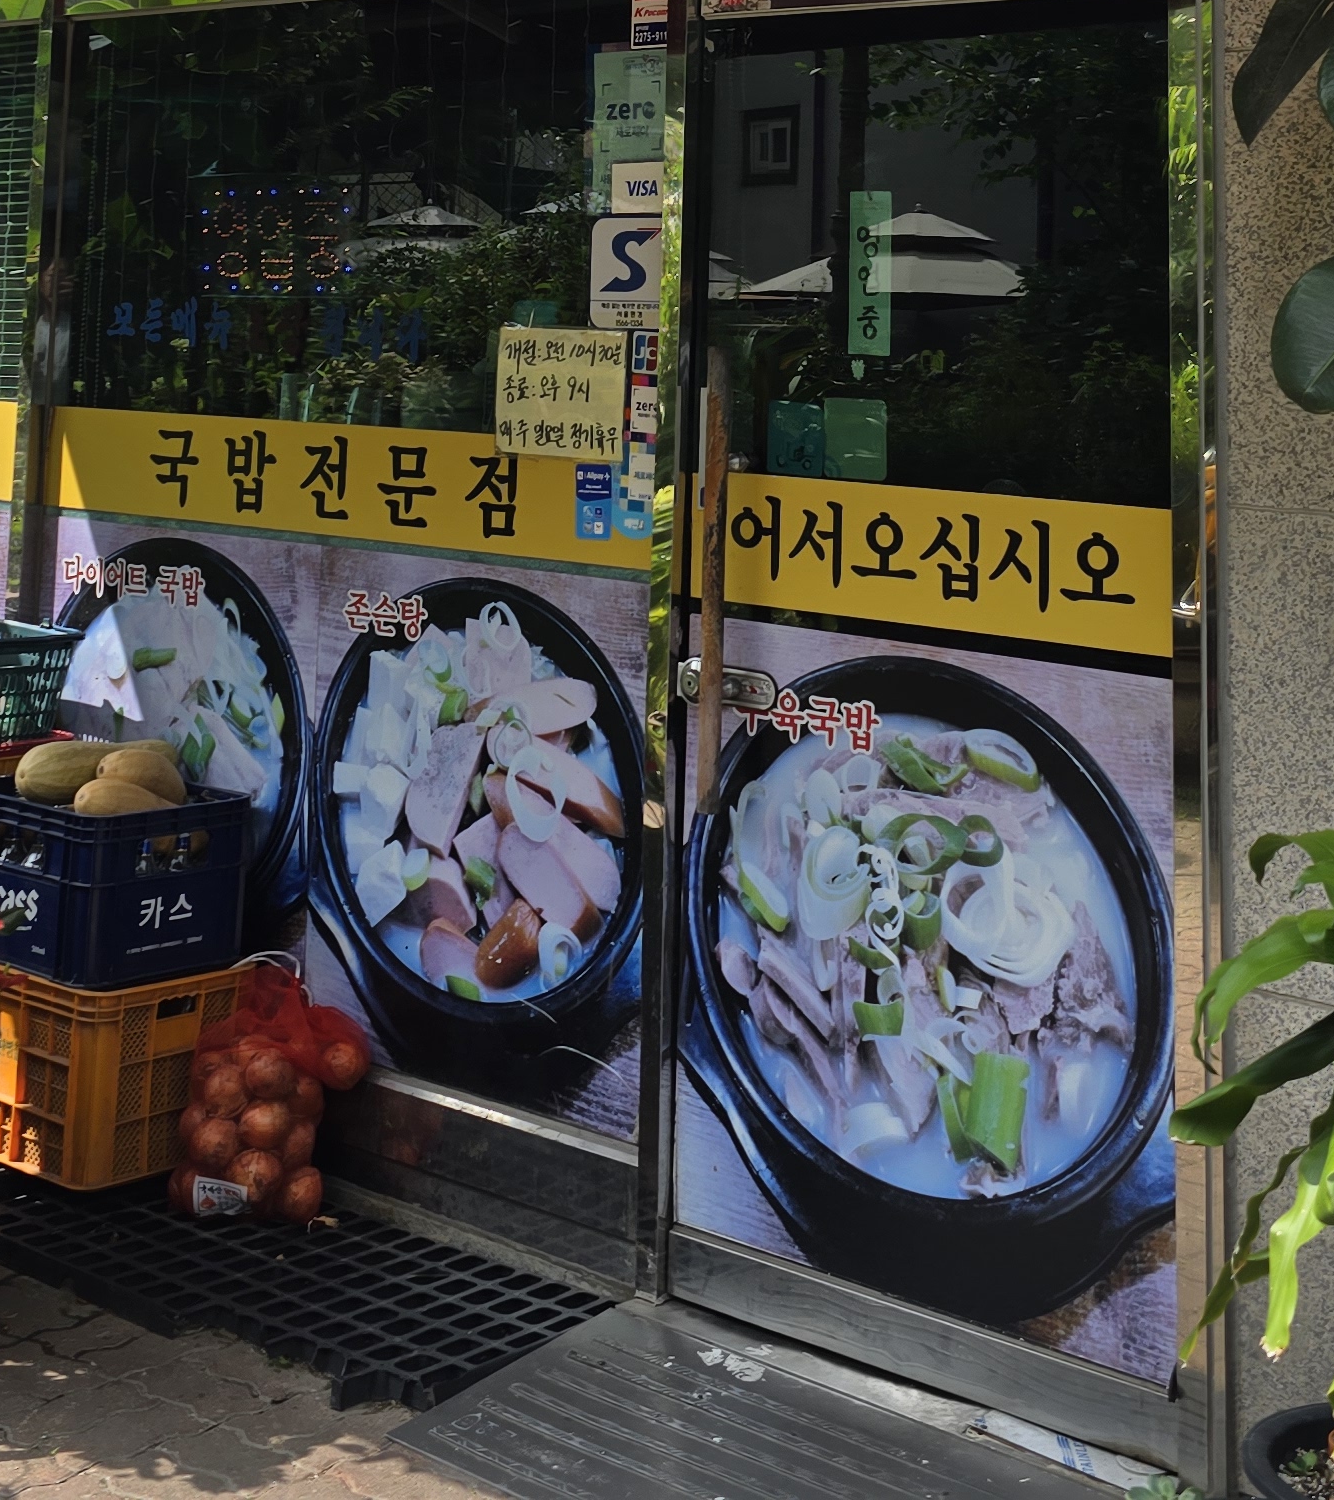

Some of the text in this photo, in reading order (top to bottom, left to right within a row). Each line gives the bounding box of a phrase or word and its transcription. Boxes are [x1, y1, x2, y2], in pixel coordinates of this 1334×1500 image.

[606, 101, 656, 121] zero
[625, 179, 659, 197] VISA
[212, 201, 341, 280] 영업중
[539, 373, 561, 402] 오후
[149, 428, 520, 539] 국밥전문점
[730, 495, 1137, 614] 어서오십시오
[62, 555, 207, 608] 다이어트 국밥
[344, 591, 429, 641] 존슨탕
[138, 893, 193, 929] 카스
